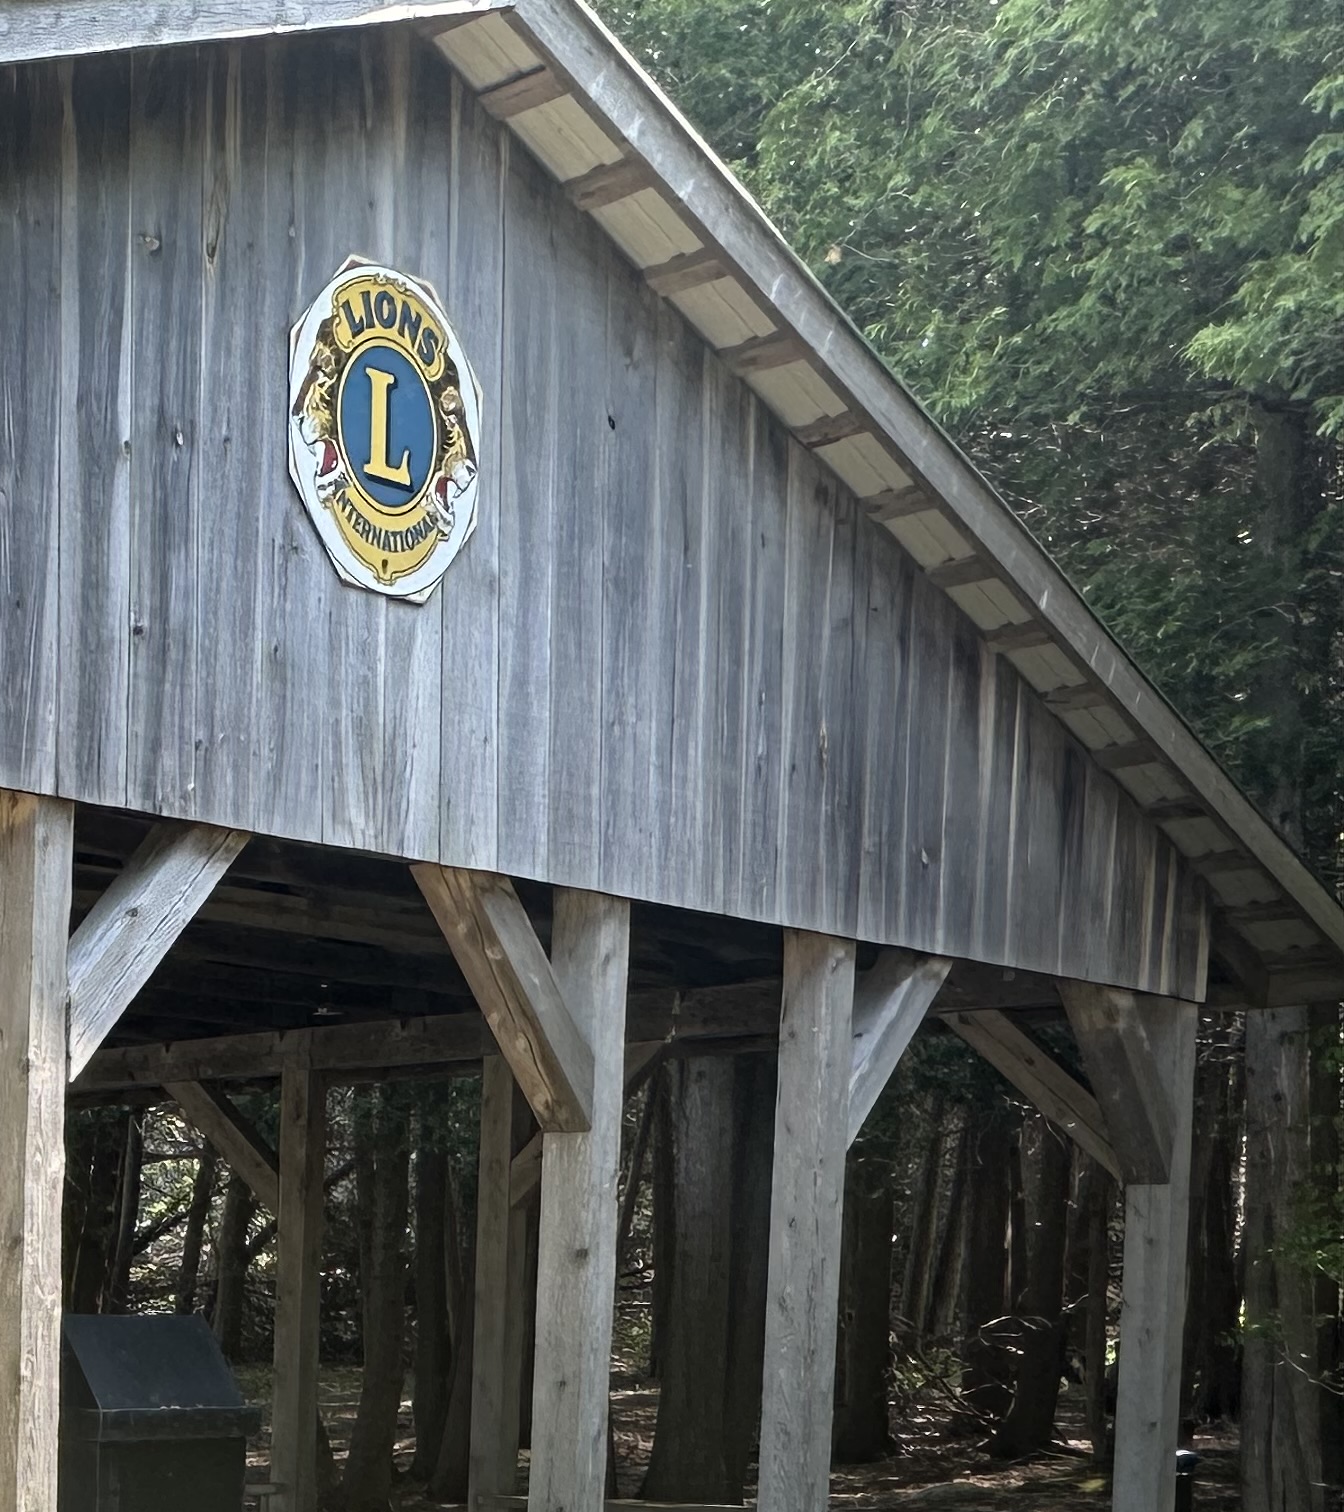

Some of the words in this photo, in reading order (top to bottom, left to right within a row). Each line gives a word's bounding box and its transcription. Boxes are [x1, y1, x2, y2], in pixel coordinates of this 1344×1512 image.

[341, 290, 441, 364] LIONS
[363, 366, 413, 488] L
[334, 487, 438, 553] NTERNATIONA
